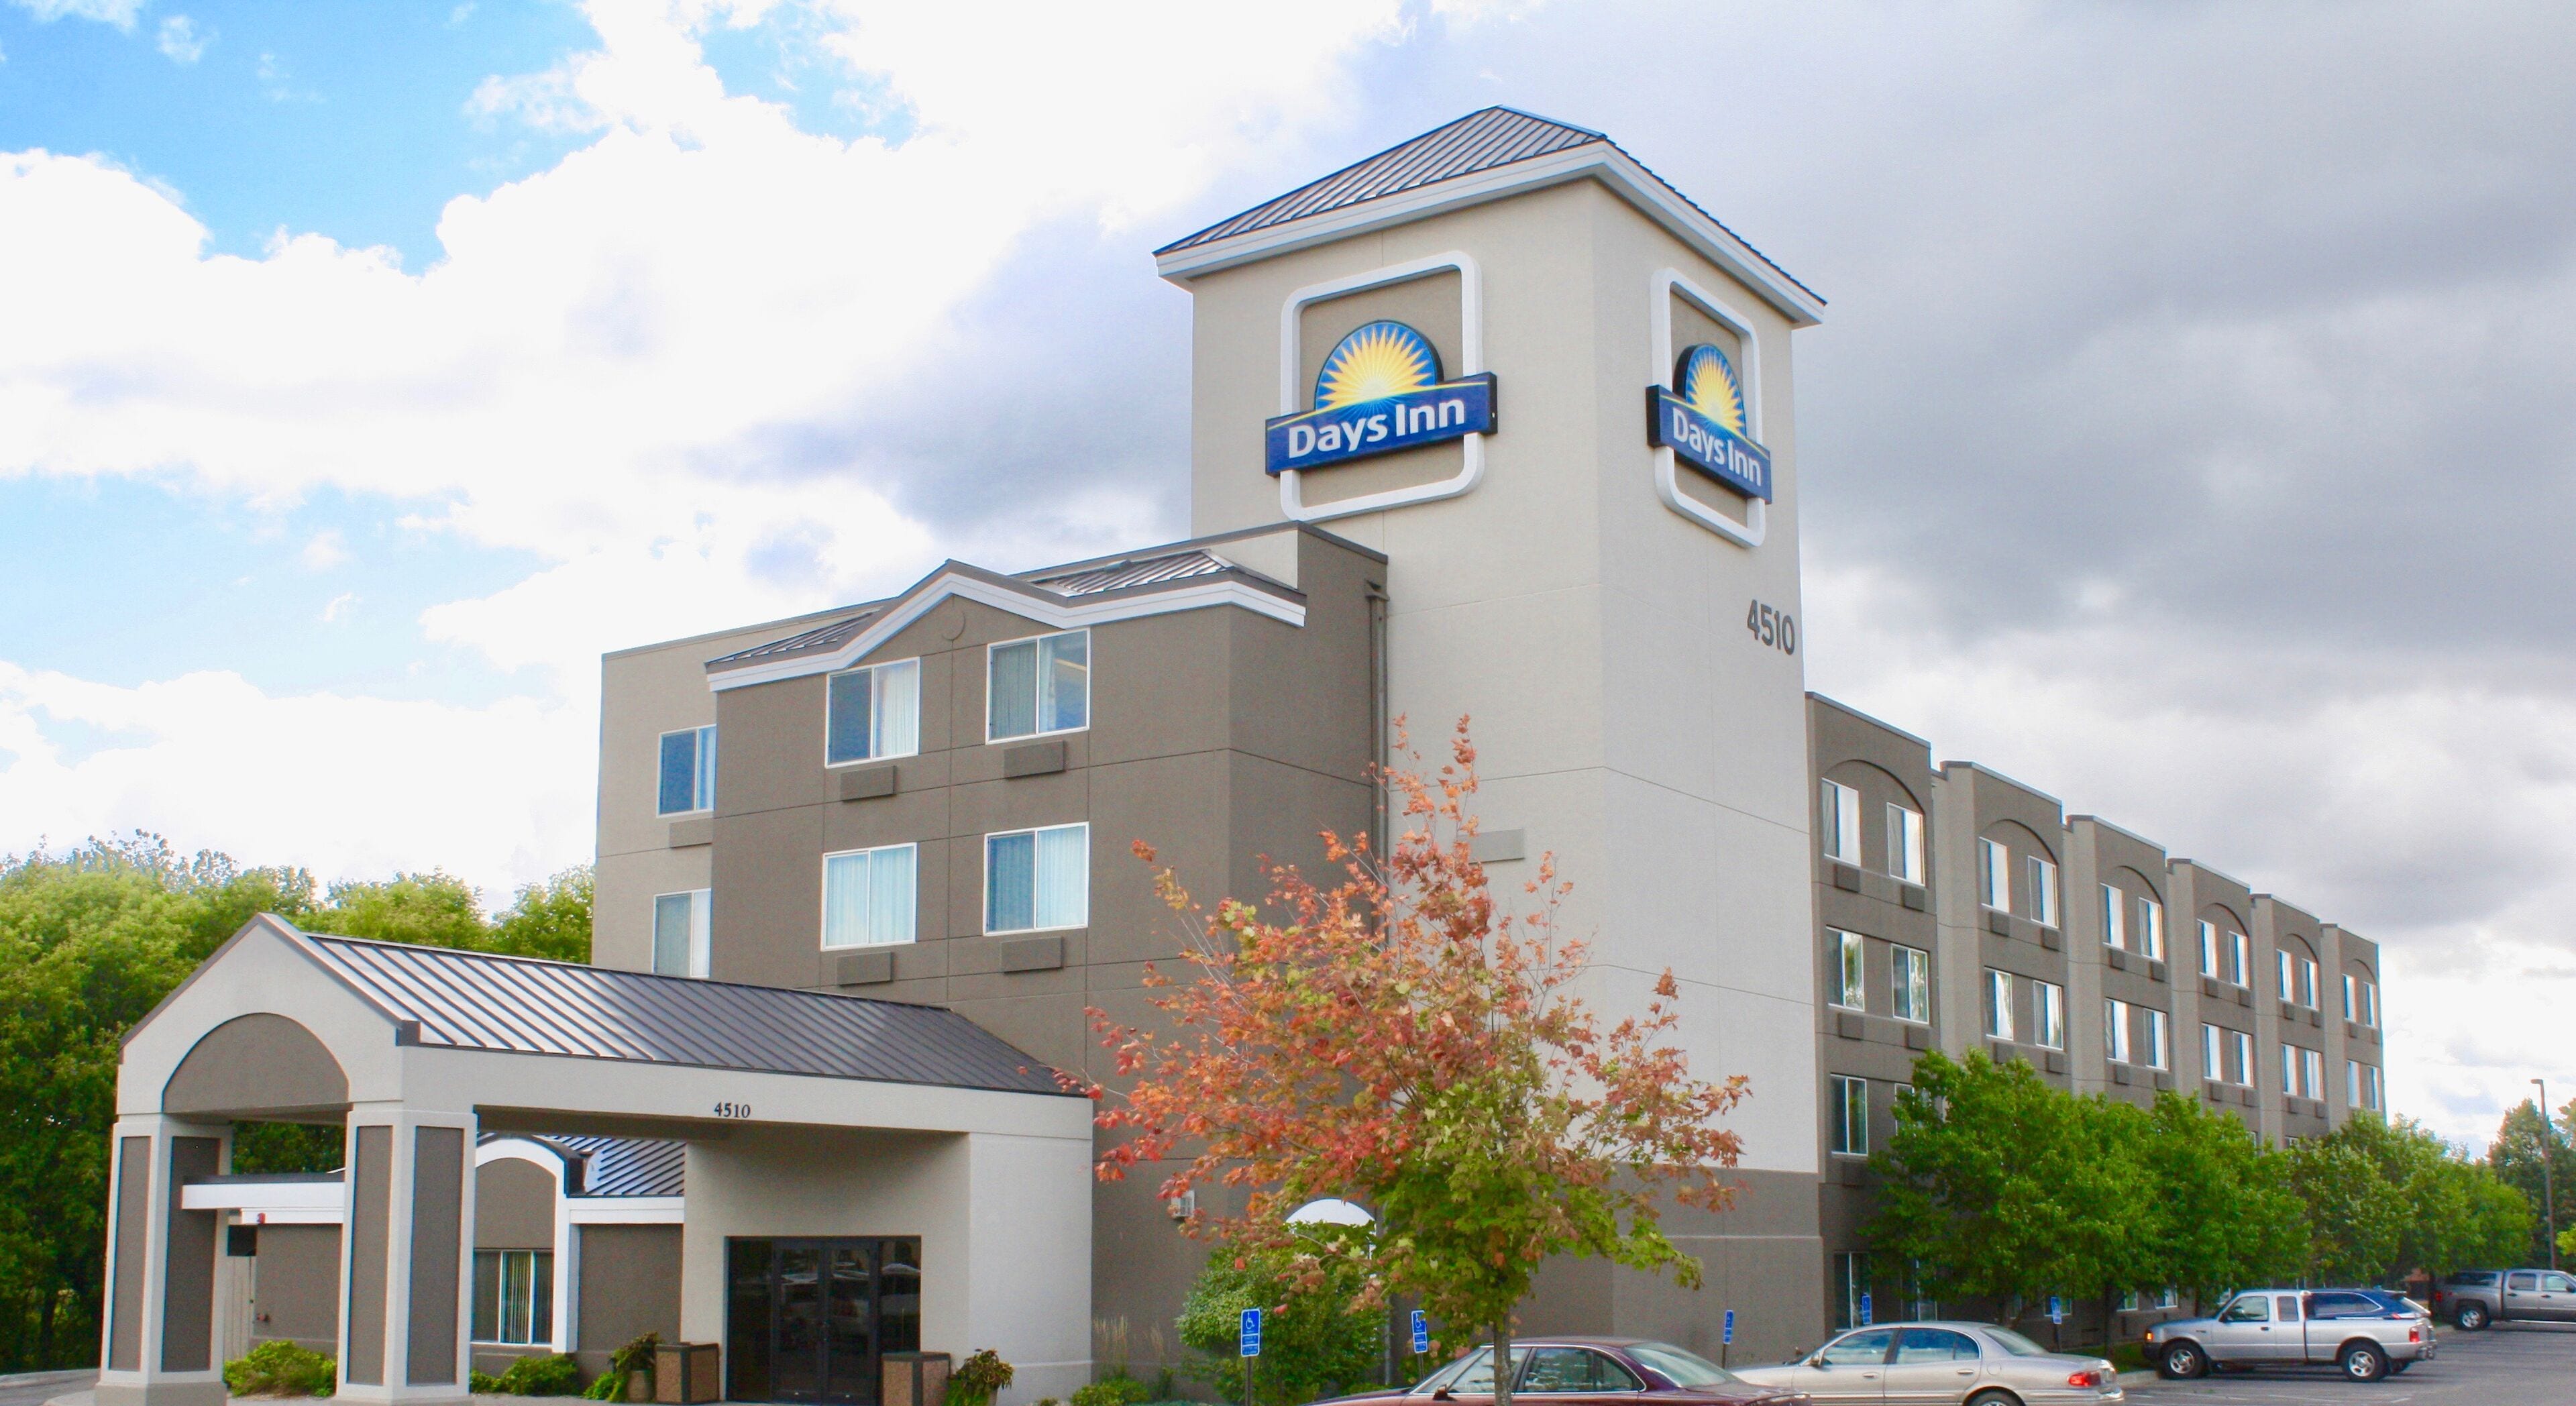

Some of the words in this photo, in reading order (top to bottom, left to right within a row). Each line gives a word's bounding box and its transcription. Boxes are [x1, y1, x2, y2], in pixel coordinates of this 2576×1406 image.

[1288, 413, 1388, 459] Days
[1395, 399, 1465, 437] Inn
[1673, 407, 1725, 465] Days
[1727, 439, 1762, 487] Inn
[1747, 599, 1795, 655] 4510
[713, 1101, 751, 1118] 4510
